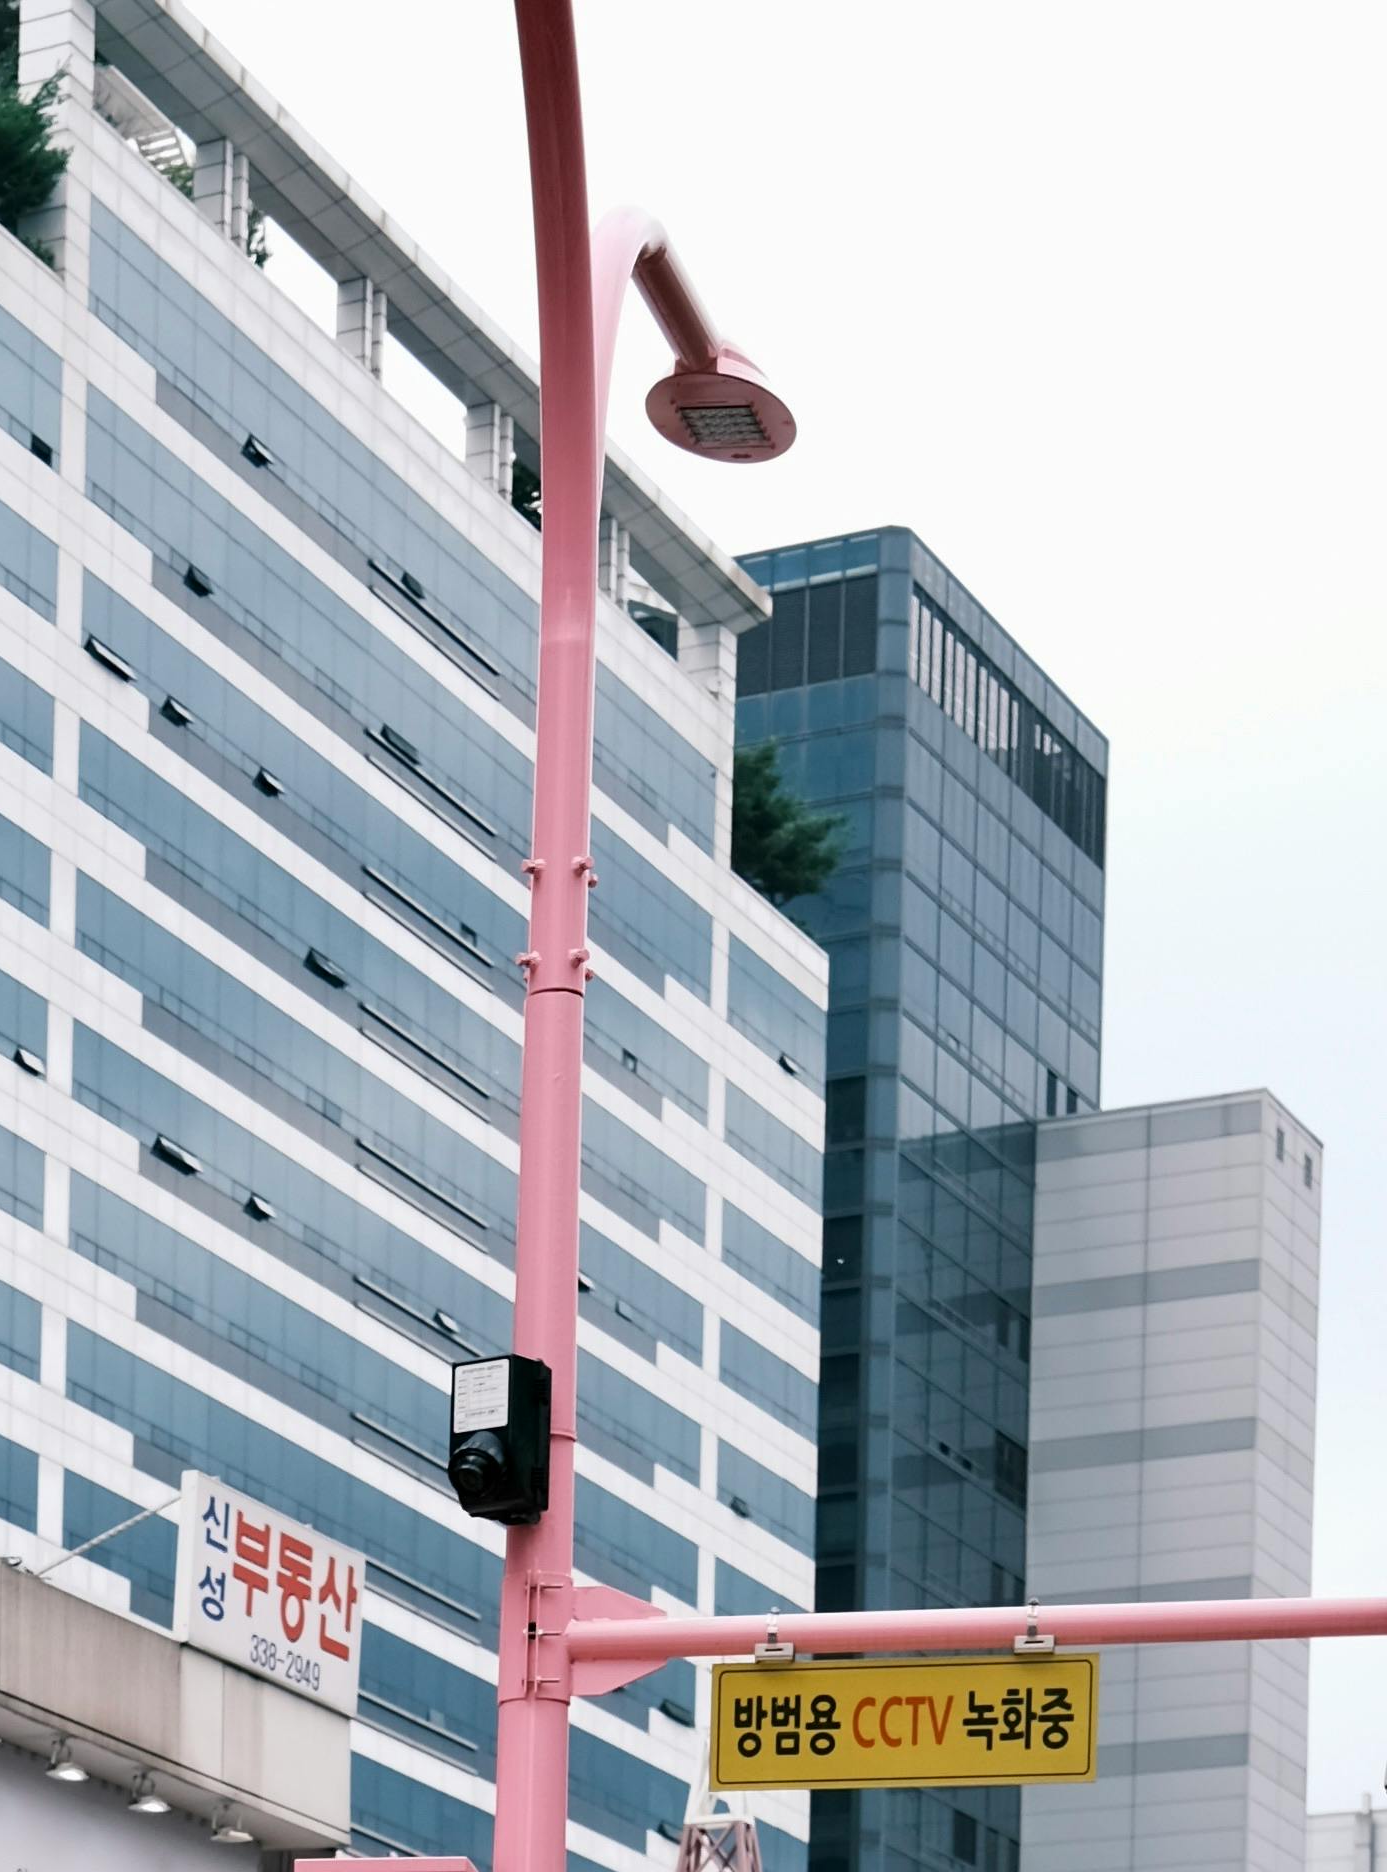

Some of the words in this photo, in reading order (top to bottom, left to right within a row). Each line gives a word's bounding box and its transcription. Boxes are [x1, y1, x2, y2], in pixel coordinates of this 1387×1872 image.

[199, 1496, 230, 1622] 신성
[233, 1509, 358, 1663] 부동산
[249, 1634, 321, 1692] 338-2949
[733, 1694, 842, 1758] 방범용
[852, 1696, 954, 1750] CCTV
[962, 1687, 1075, 1753] 녹화중
